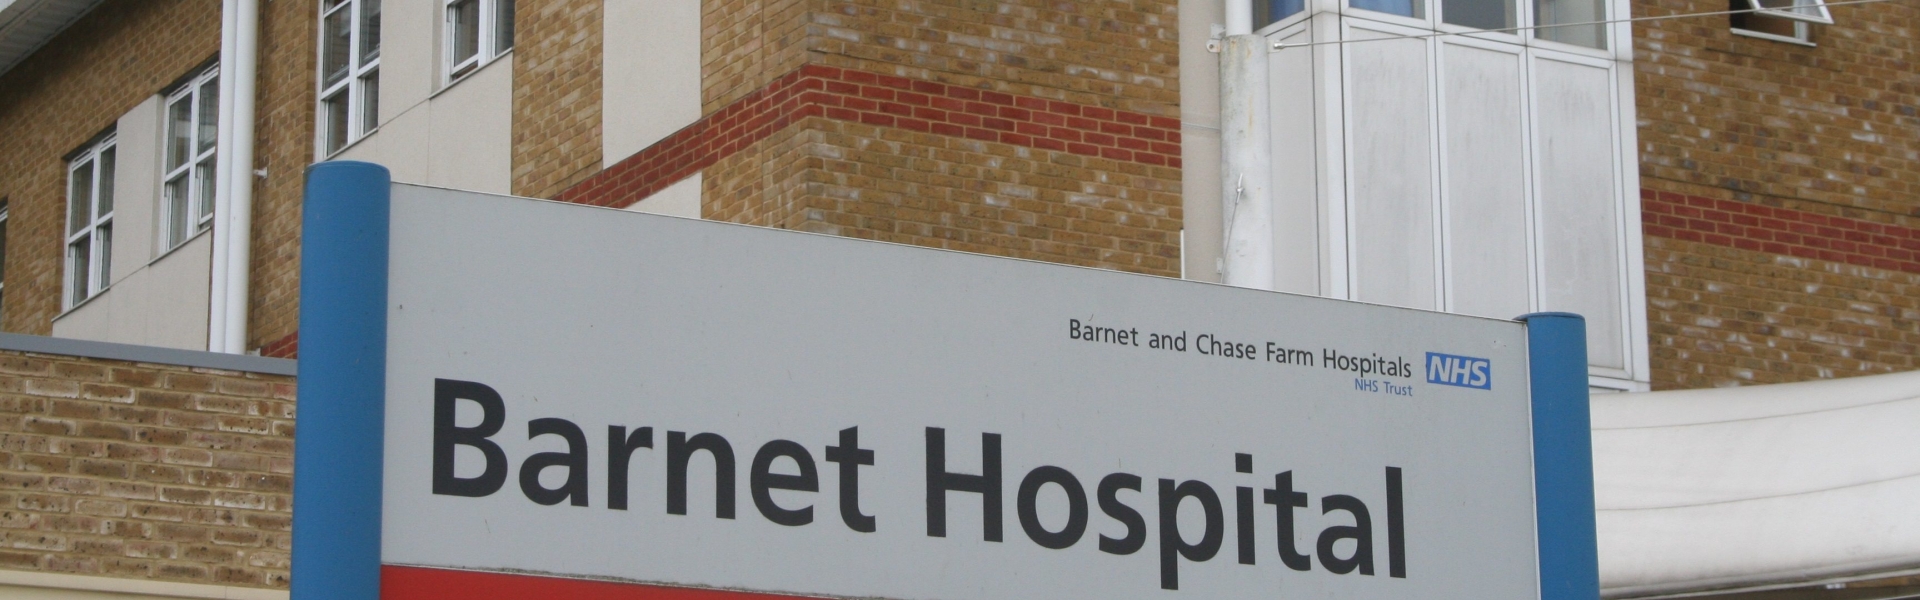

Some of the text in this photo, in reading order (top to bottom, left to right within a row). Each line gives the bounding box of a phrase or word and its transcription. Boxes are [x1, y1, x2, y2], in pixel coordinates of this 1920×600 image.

[1070, 319, 1412, 378] Barnet and Chase Farm Hospitals
[1428, 355, 1488, 388] NHS
[1355, 378, 1413, 397] NHS Trust
[432, 378, 1407, 591] Barnet Hospital
